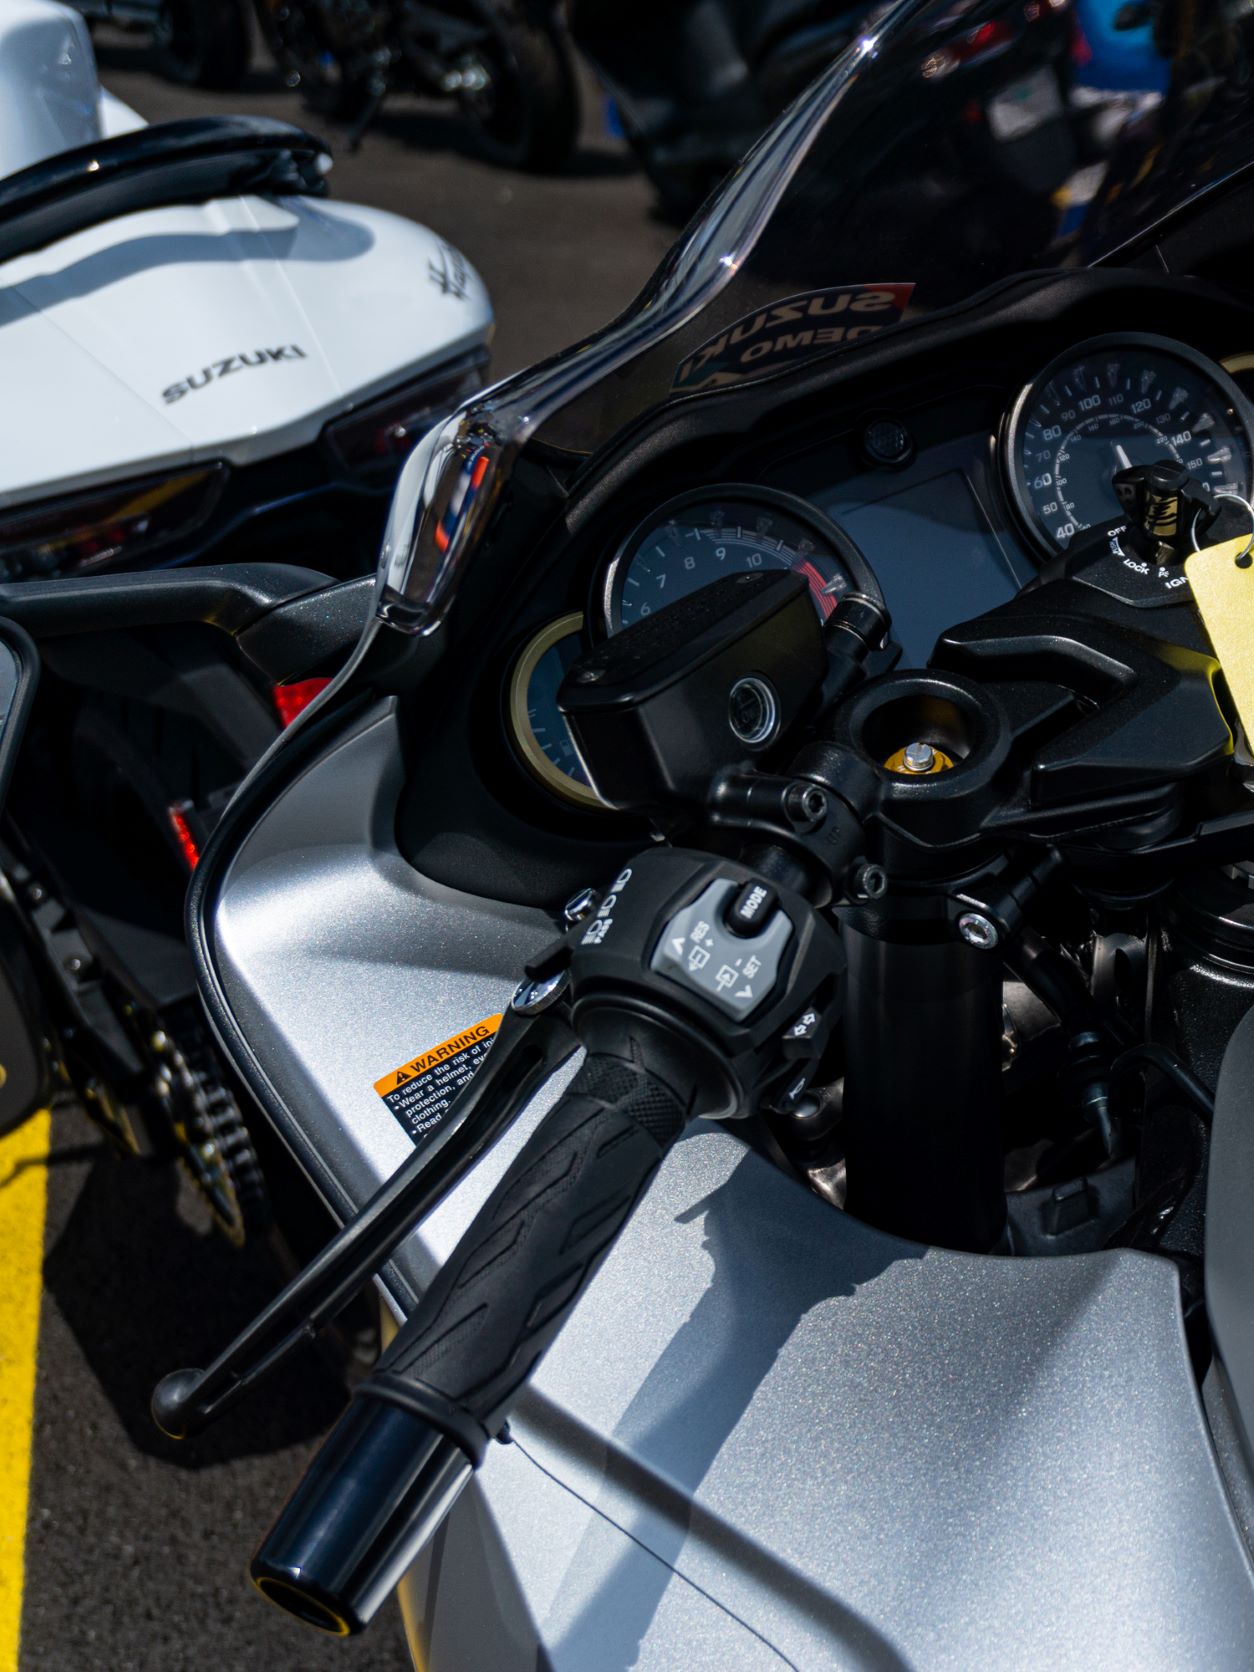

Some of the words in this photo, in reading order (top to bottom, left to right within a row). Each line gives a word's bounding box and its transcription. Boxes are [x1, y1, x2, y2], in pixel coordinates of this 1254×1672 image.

[162, 343, 308, 405] SUZUKI
[1078, 394, 1101, 410] 100
[1108, 393, 1124, 406] 110
[1131, 398, 1152, 414] 120
[1061, 410, 1076, 421] 90
[1156, 412, 1171, 424] 130
[1043, 425, 1062, 441] 80
[1171, 430, 1192, 446] 140
[1035, 451, 1051, 464] 70
[1187, 457, 1203, 470] 150
[1033, 473, 1052, 490] 60
[1042, 502, 1058, 515] 50
[1055, 523, 1076, 539] 40
[1107, 525, 1127, 537] OFF
[715, 547, 727, 561] 9
[746, 552, 762, 568] 10
[684, 556, 696, 570] 8
[1123, 559, 1150, 575] LOCK
[656, 574, 666, 589] 7
[640, 602, 651, 616] 6
[739, 886, 767, 919] MODE
[690, 920, 711, 943] RES
[742, 955, 762, 979] SET
[410, 1025, 490, 1073] WARNING
[387, 1093, 400, 1104] To
[402, 1074, 433, 1095] reduce
[434, 1064, 450, 1078] the
[453, 1052, 470, 1066] risk
[471, 1045, 482, 1056] of
[399, 1089, 425, 1109] Wear
[427, 1084, 435, 1093] a
[405, 1083, 456, 1118] protection,
[457, 1071, 475, 1086] and
[411, 1098, 451, 1126] clothing.
[417, 1114, 442, 1134] Read
